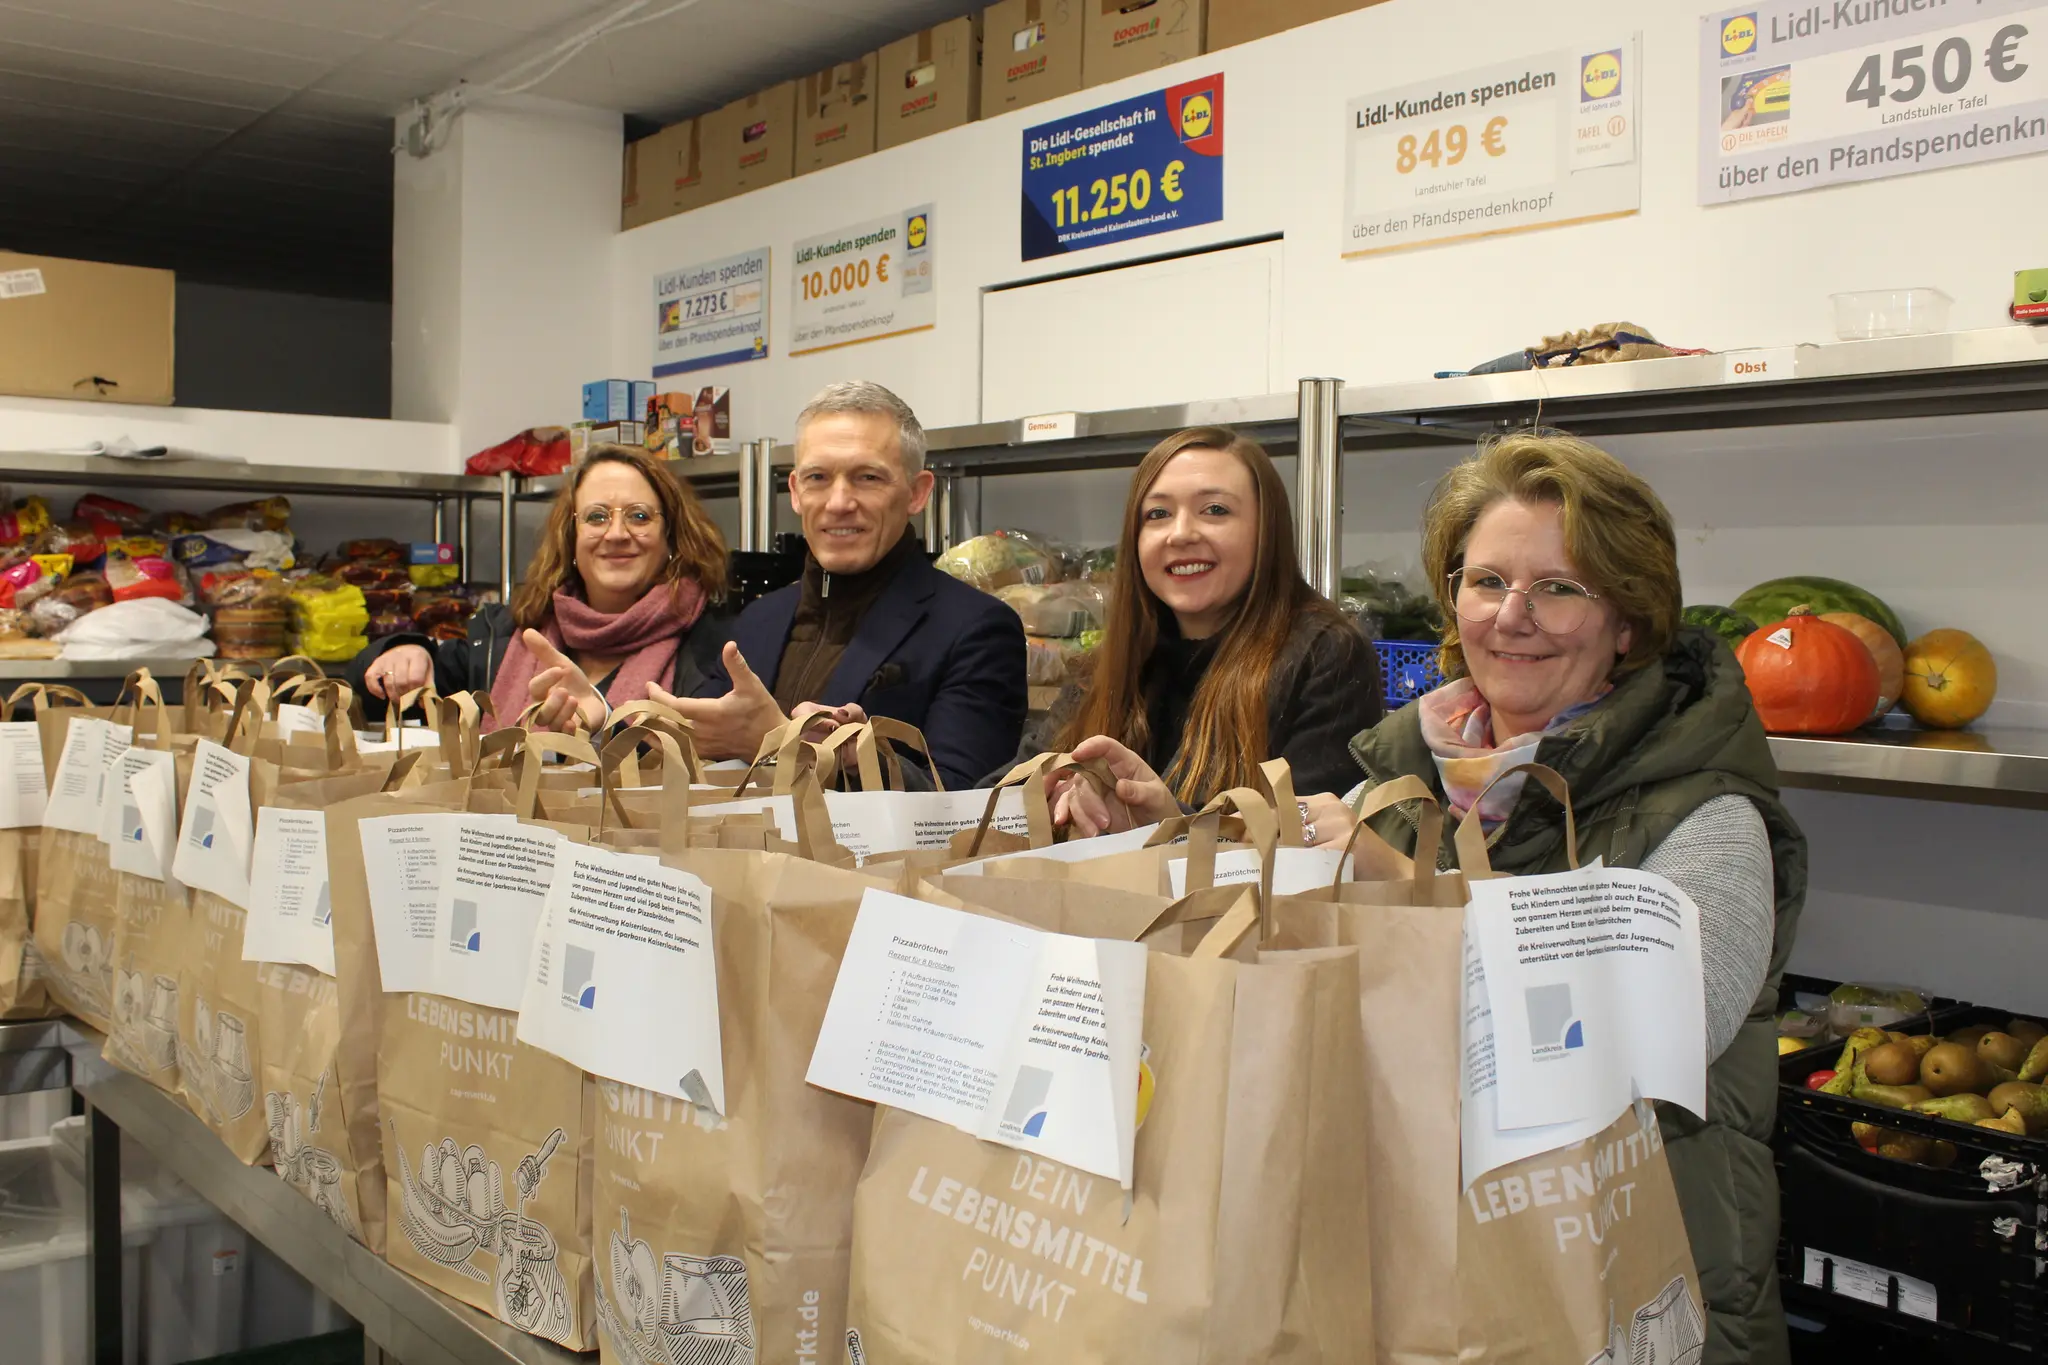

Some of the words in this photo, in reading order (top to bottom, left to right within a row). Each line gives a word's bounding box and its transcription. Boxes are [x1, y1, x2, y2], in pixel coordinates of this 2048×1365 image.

[1846, 36, 1973, 109] 450
[1984, 23, 2029, 83] €
[1356, 91, 1466, 129] Lidl-Kunden
[1470, 71, 1556, 106] spenden
[1882, 103, 1953, 125] Landstuhler
[1959, 95, 1988, 111] Tafel
[1030, 140, 1048, 153] Die
[1050, 111, 1142, 148] Lidl-Gesellschaft
[1145, 107, 1156, 121] in
[1396, 124, 1468, 174] 849
[1481, 116, 1508, 157] €
[1578, 126, 1600, 139] TAFEL
[1756, 125, 1788, 138] TAFELN
[1030, 156, 1044, 170] St.
[1046, 145, 1087, 167] Ingbert
[1088, 132, 1134, 157] spendet
[1719, 166, 1768, 189] über
[1777, 155, 1819, 180] den
[1830, 115, 2048, 171] Pfandspendenkn
[1052, 168, 1151, 227] 11.250
[1160, 160, 1185, 202] €
[1414, 180, 1464, 197] Landstuhler
[1466, 175, 1487, 188] Tafel
[1058, 233, 1071, 243] DRK
[1071, 224, 1108, 240] Kreisverband
[1109, 212, 1166, 233] Kaiserslautern-Land
[1352, 222, 1380, 239] über
[1384, 218, 1408, 233] den
[1412, 192, 1554, 229] Pfandspendenknopf
[796, 240, 852, 264] Lidl-Kunden
[854, 227, 896, 250] spenden
[659, 269, 716, 296] Lidl-Kunden
[720, 256, 762, 281] spenden
[801, 259, 870, 300] 10.000
[876, 254, 890, 282] €
[685, 294, 718, 320] 7.273
[719, 292, 728, 311] €
[1735, 361, 1767, 374] Obst
[997, 815, 1010, 823] Jahr
[574, 871, 585, 880] Euch
[586, 874, 606, 885] Kindern
[619, 882, 654, 897] Jugendlichen
[664, 893, 676, 902] auch
[575, 861, 589, 870] Frohe
[590, 864, 624, 878] Weihnachten
[647, 879, 660, 889] gutes
[662, 882, 677, 892] Neues
[1509, 890, 1530, 899] Frohe
[1532, 885, 1578, 896] Weihnachten
[1612, 882, 1636, 890] Neues
[1639, 884, 1656, 894] Jahr
[571, 892, 597, 905] Zubereiten
[598, 900, 608, 908] und
[609, 902, 625, 911] Essen
[626, 906, 637, 914] der
[638, 908, 675, 924] Pizzabrötchen
[582, 886, 602, 896] ganzem
[603, 889, 622, 900] Herzen
[624, 895, 636, 903] und
[1511, 902, 1529, 911] Euch
[1531, 899, 1560, 909] Kindern
[1561, 897, 1574, 905] und
[1604, 893, 1613, 901] als
[1637, 896, 1659, 906] Eurer
[577, 908, 619, 926] Kreisverwaltung
[620, 920, 663, 937] Kaiserslautern,
[664, 930, 673, 939] das
[1515, 924, 1554, 935] Zubereiten
[1556, 922, 1569, 930] und
[1571, 921, 1587, 929] Essen
[1529, 912, 1557, 923] ganzem
[1559, 909, 1582, 918] Herzen
[606, 927, 616, 935] der
[617, 930, 647, 944] Sparkasse
[648, 937, 685, 953] Kaiserslautern
[892, 936, 948, 956] Pizzabrötchen
[1518, 944, 1529, 952] die
[1530, 937, 1585, 951] Kreisverwaltung
[1630, 933, 1675, 950] Jugendamt
[1520, 953, 1559, 964] unterstützt
[1561, 951, 1574, 959] von
[1050, 973, 1065, 982] Frohe
[1059, 987, 1082, 997] Kindern
[1083, 993, 1097, 1001] und
[1076, 1002, 1099, 1014] Herzen
[1038, 1008, 1066, 1019] Zubereiten
[1067, 1014, 1081, 1022] und
[1082, 1017, 1099, 1027] Essen
[439, 1041, 514, 1081] PUNKT
[1058, 1042, 1070, 1050] von
[1071, 1045, 1083, 1054] der
[1532, 1045, 1562, 1054] Landkreis
[1010, 1155, 1093, 1216] DEIN
[1554, 1182, 1636, 1253] PUNKT
[908, 1165, 1148, 1304] LEBENSMITTEL
[963, 1247, 1077, 1323] PUNKT
